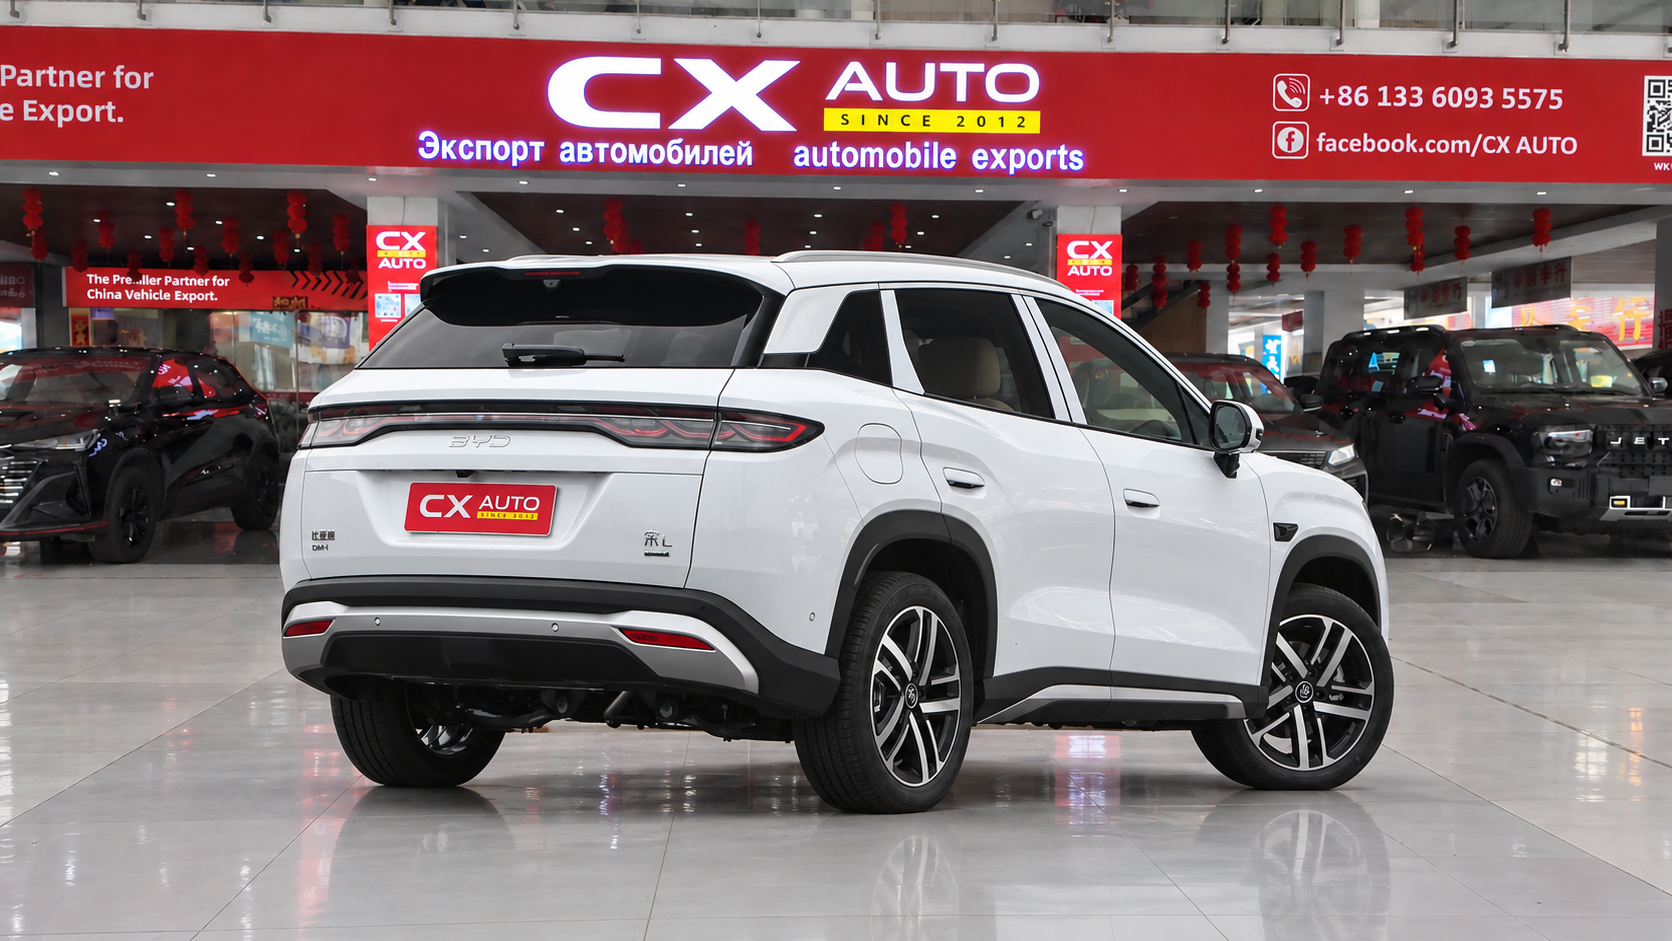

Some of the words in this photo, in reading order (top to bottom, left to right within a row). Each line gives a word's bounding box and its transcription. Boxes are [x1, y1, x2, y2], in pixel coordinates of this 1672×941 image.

[0, 64, 106, 88] Partner
[113, 65, 154, 89] for
[825, 61, 1040, 103] AUTO
[547, 56, 801, 132] CX
[1319, 86, 1370, 107] +86
[1377, 86, 1424, 107] 133
[1432, 86, 1495, 108] 6093
[1501, 88, 1564, 109] 5575
[23, 99, 124, 128] Export.
[841, 114, 931, 127] SINCE
[956, 115, 1026, 128] 2012
[417, 130, 546, 167] Экспорт
[558, 137, 753, 166] автомобилей
[1316, 132, 1510, 157] facebook.com/CX
[1515, 136, 1578, 154] AUTO
[793, 140, 957, 169] automobile
[972, 144, 1085, 175] exports
[375, 230, 426, 251] CX
[1066, 240, 1114, 259] CX
[377, 258, 427, 269] AUTO
[1067, 265, 1113, 277] AUTO
[86, 273, 110, 285] The
[164, 275, 210, 287] Partner
[212, 275, 231, 287] for
[86, 288, 122, 300] China
[125, 288, 171, 301] Vehicle
[174, 290, 218, 303] Export.
[448, 435, 511, 448] BYD
[419, 494, 474, 519] CX
[478, 495, 541, 511] AUTO
